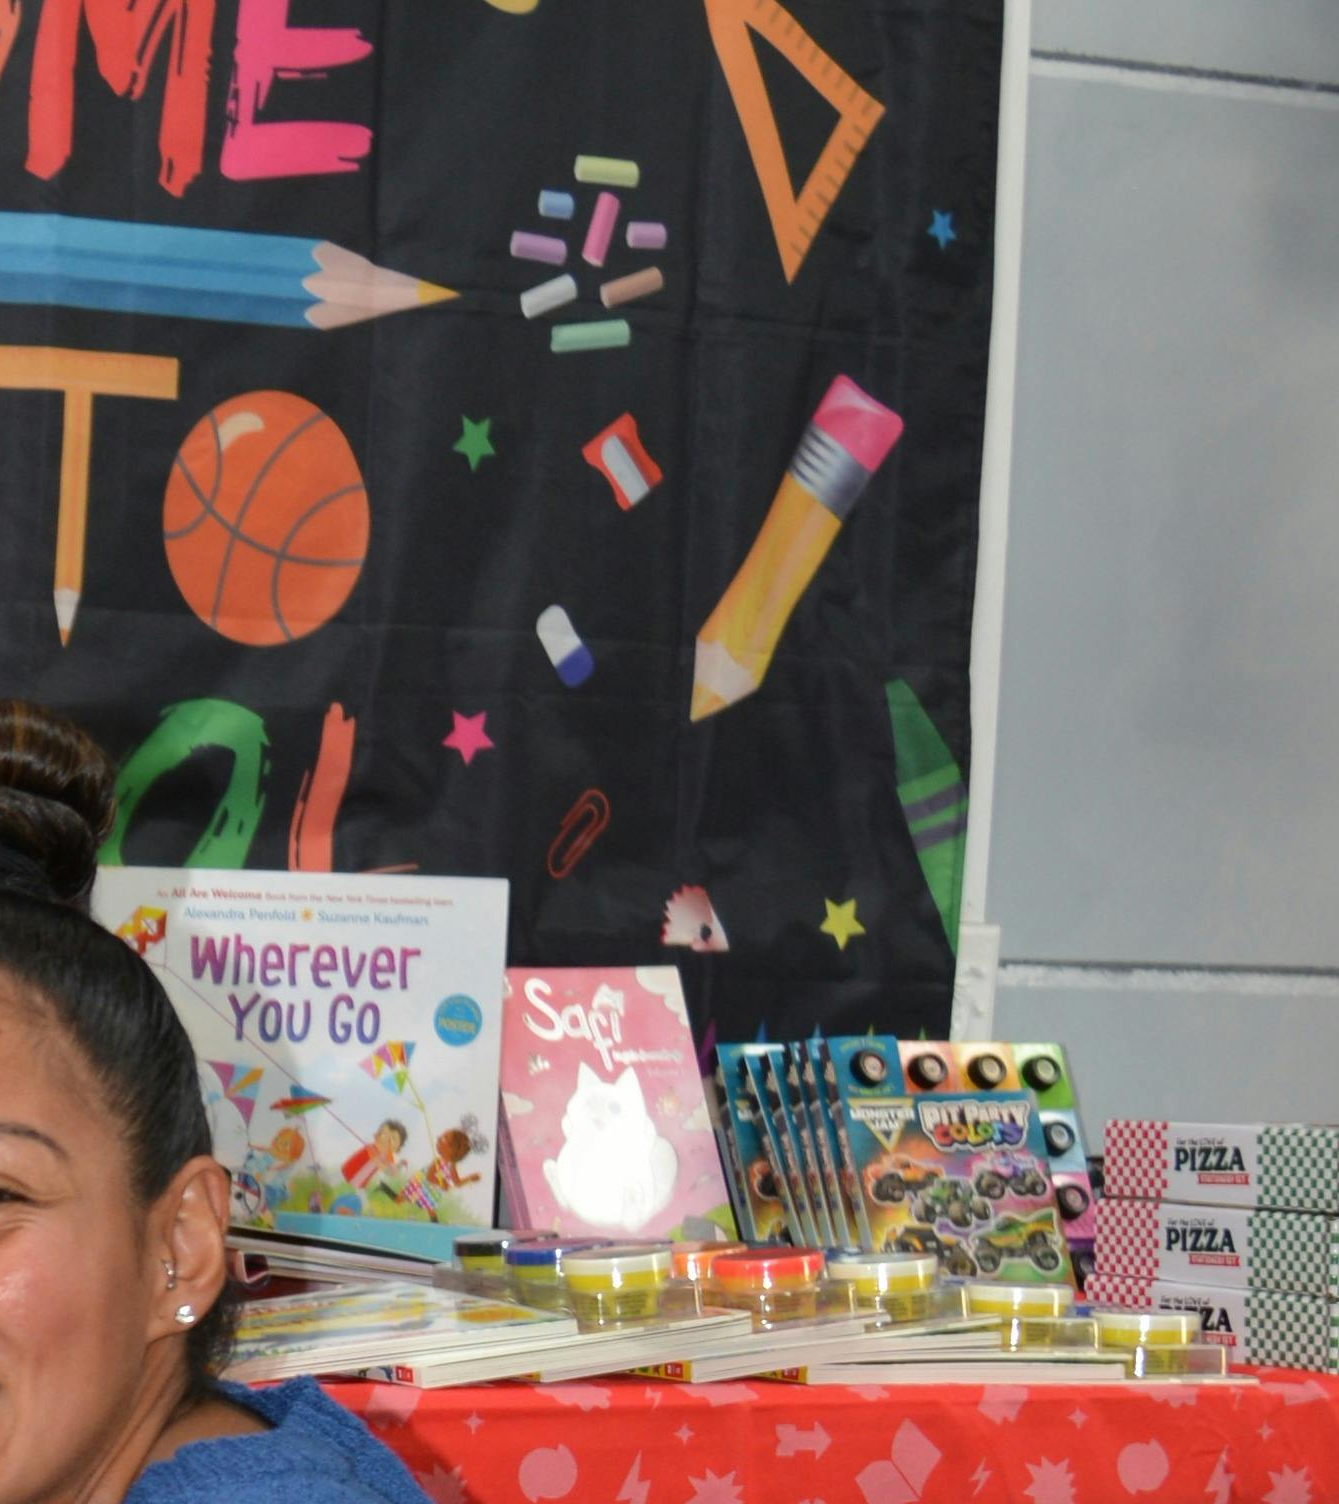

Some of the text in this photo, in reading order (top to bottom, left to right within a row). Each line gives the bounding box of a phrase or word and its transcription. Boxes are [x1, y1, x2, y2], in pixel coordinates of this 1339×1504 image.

[185, 906, 246, 921] Alexandra
[317, 910, 370, 924] Suzanne
[189, 933, 422, 991] Wherever
[226, 992, 312, 1044] YOU
[328, 993, 381, 1045] GO
[849, 1107, 916, 1121] MONSTER
[873, 1118, 900, 1131] JAM
[923, 1104, 964, 1133] PIT
[933, 1120, 1024, 1146] COLORS
[1174, 1146, 1246, 1172] PIZZA
[1165, 1227, 1237, 1253] PIZZA
